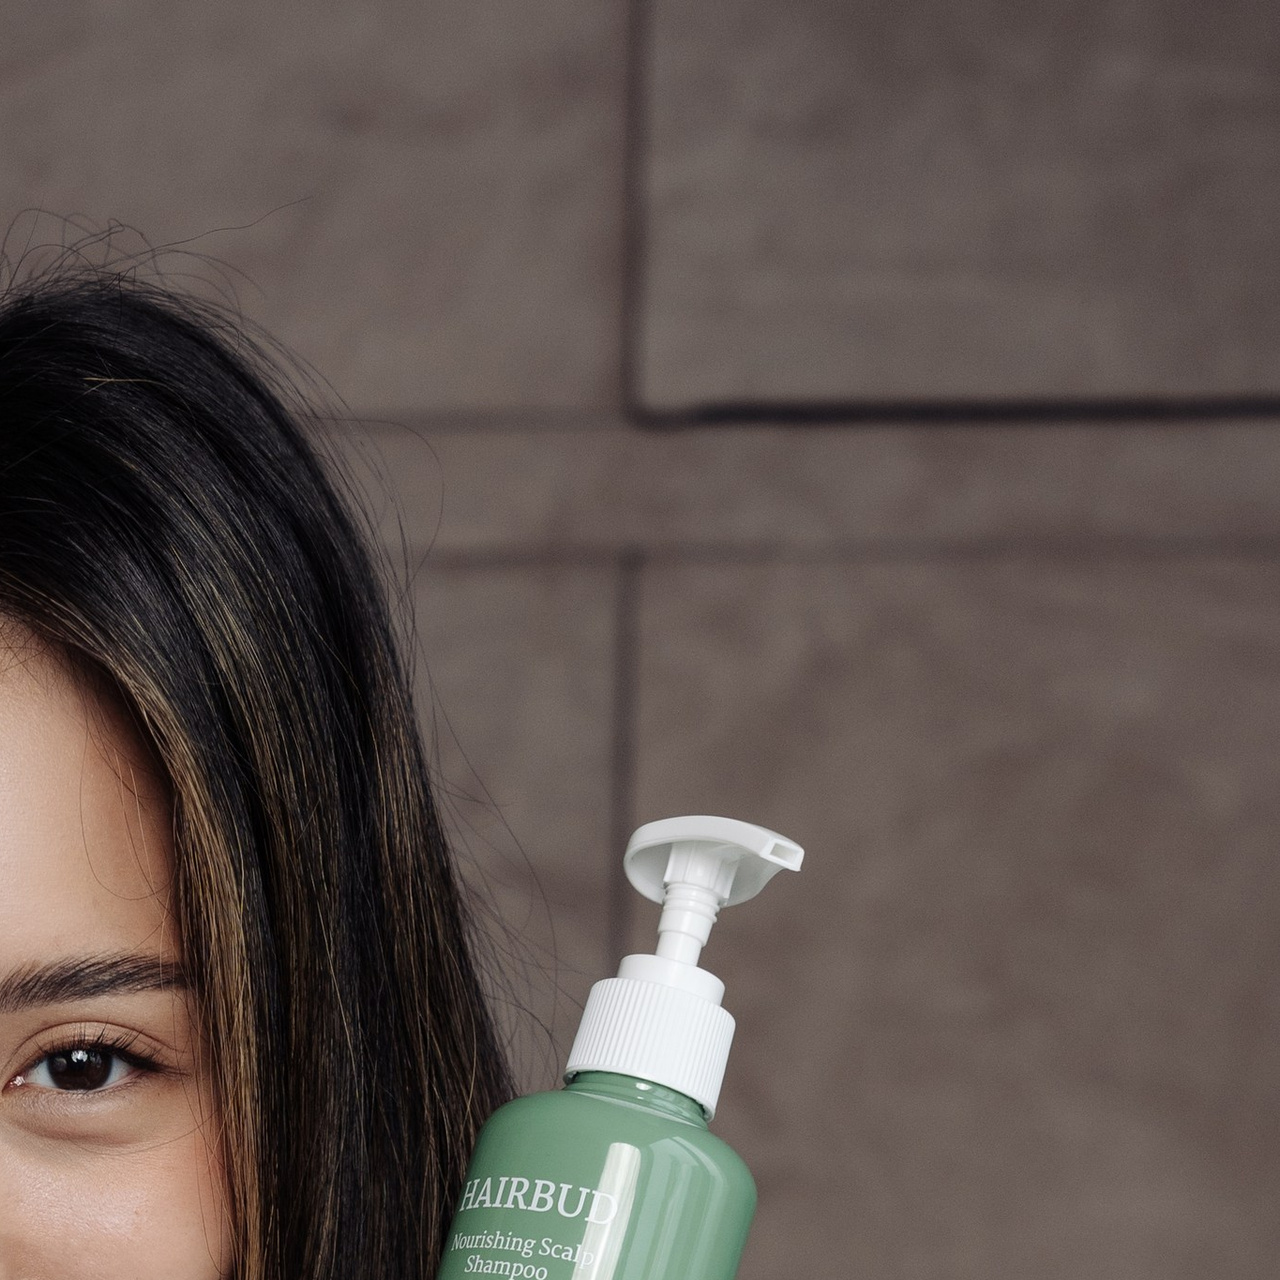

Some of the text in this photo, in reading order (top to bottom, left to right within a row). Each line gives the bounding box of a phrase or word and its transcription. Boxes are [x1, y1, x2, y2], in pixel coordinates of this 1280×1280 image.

[459, 1177, 618, 1225] HAIRBUD
[451, 1230, 595, 1269] Nourishing Scalp
